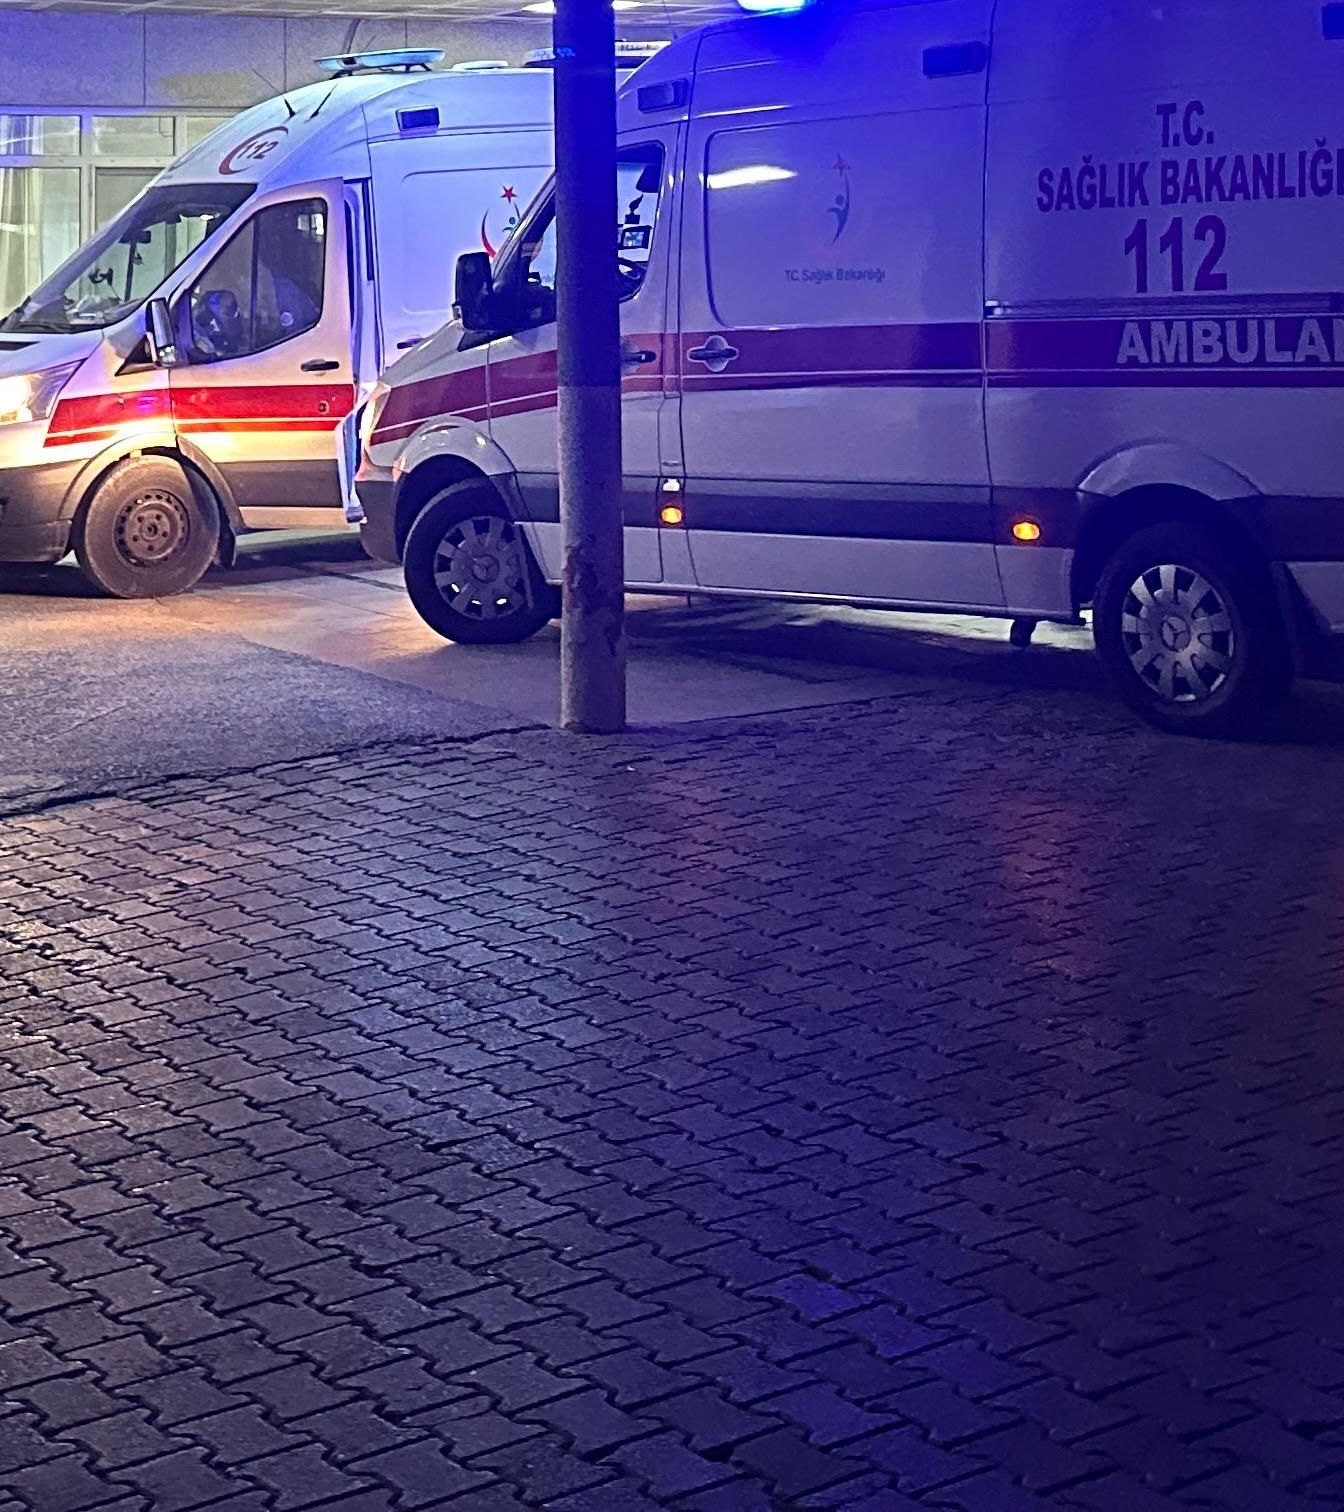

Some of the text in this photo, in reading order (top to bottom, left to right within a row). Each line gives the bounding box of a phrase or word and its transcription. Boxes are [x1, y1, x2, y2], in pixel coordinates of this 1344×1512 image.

[237, 141, 280, 160] 112
[1156, 100, 1215, 148] T.C.
[1037, 153, 1151, 213] SAĞLIK
[1124, 214, 1228, 294] 112
